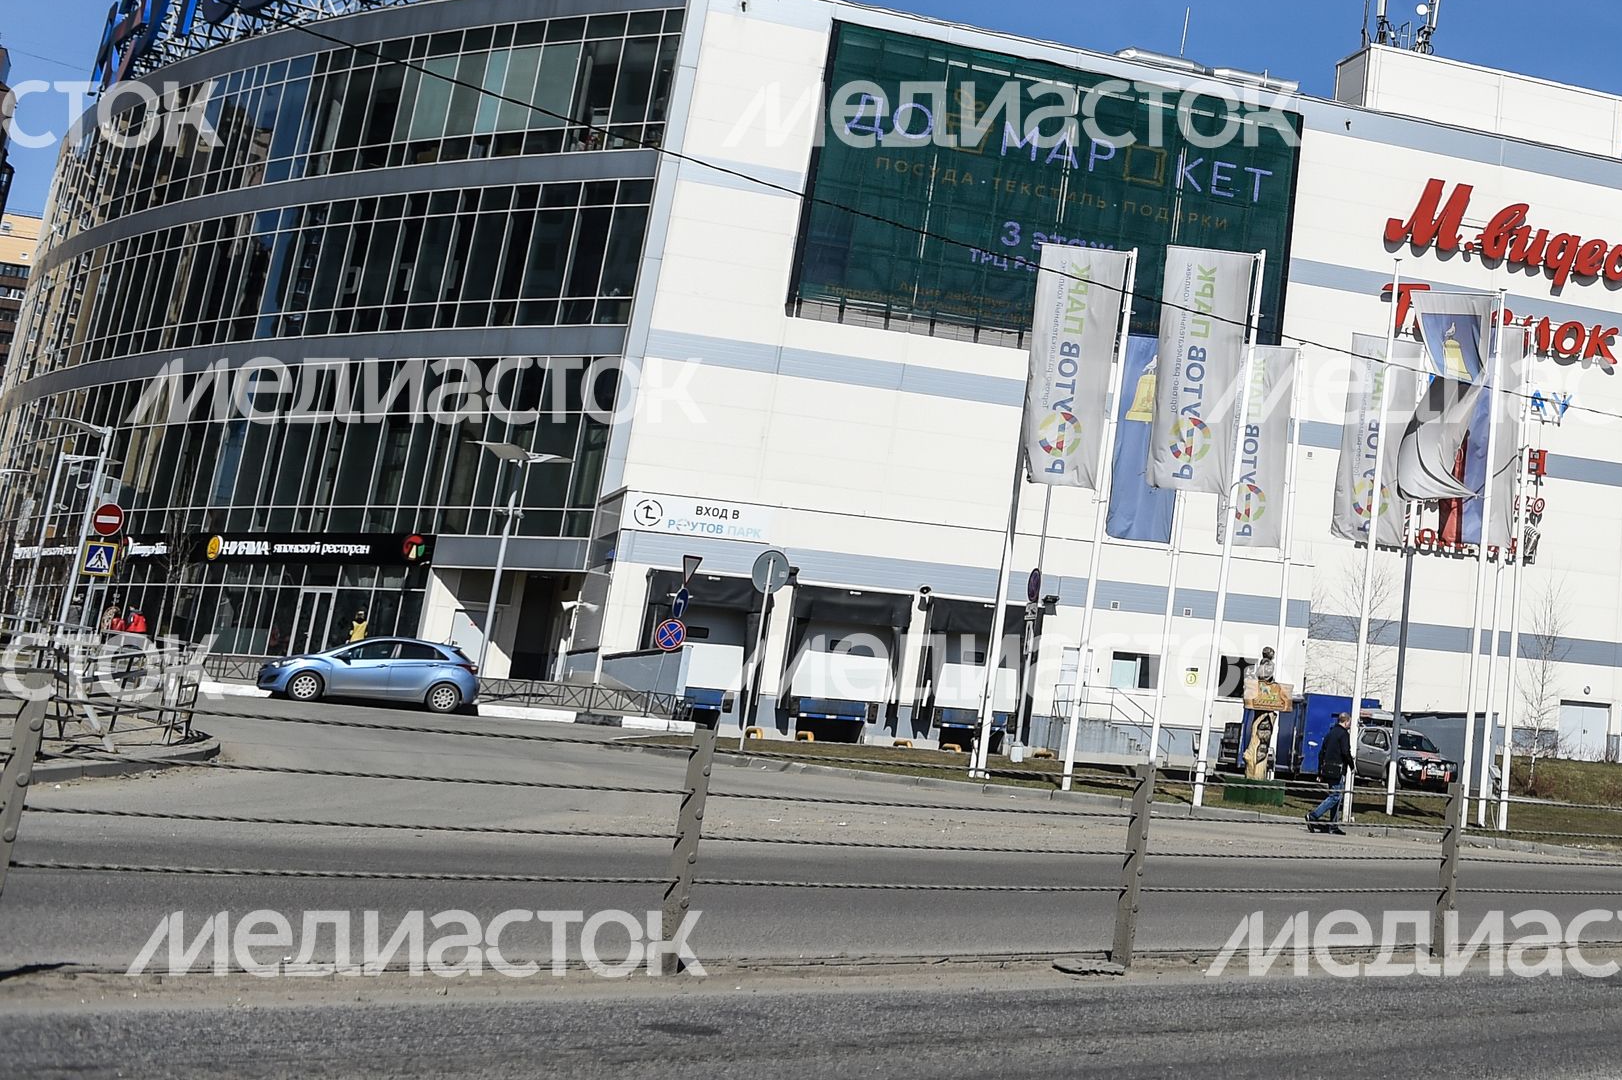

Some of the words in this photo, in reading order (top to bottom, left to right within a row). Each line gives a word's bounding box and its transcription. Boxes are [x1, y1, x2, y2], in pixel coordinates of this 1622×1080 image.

[1000, 221, 1022, 247] 3
[695, 506, 728, 520] ВХОД
[732, 509, 740, 520] В
[727, 524, 762, 539] ПАРК
[321, 543, 371, 556] ресторан
